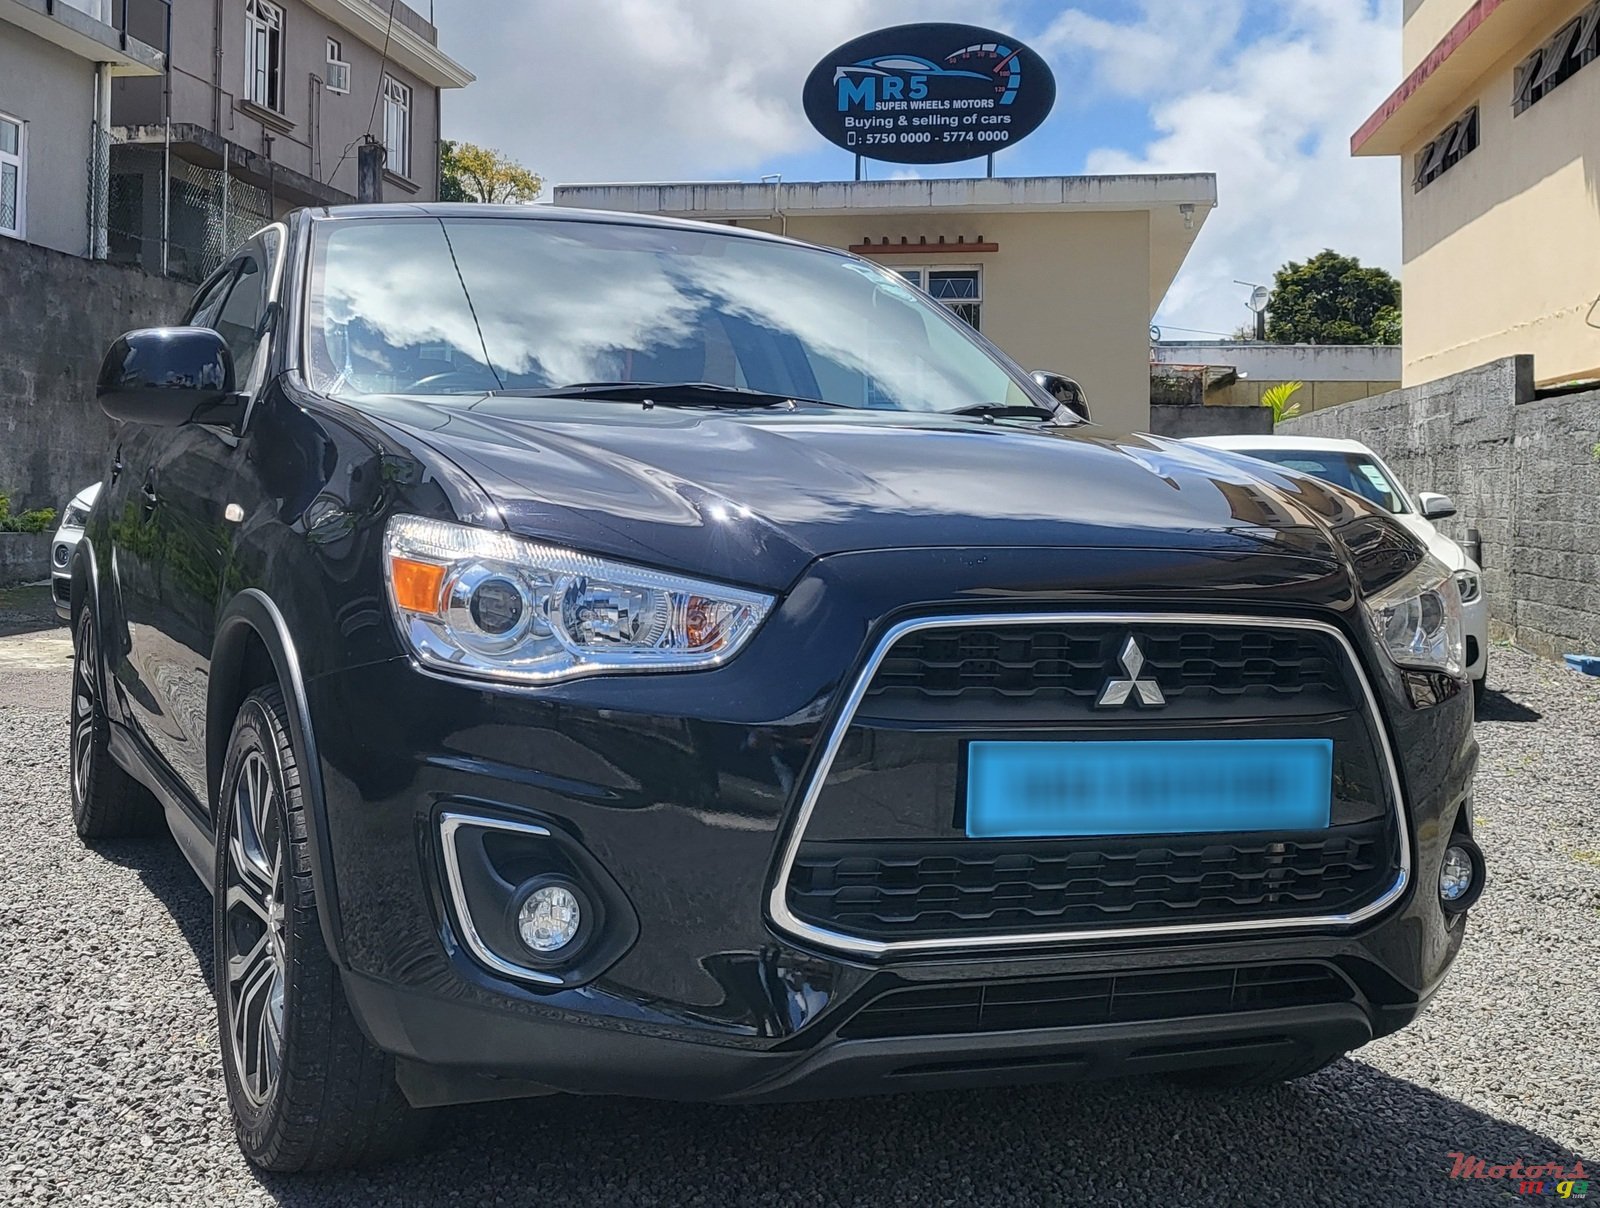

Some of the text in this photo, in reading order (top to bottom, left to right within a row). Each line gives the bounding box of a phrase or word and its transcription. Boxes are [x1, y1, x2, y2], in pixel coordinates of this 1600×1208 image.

[875, 99, 994, 111] SUPER WHEELS MOTORS
[845, 113, 1011, 129] Buying & selling of cars
[866, 133, 897, 144] 5750
[900, 132, 931, 143] 0000
[943, 131, 974, 142] 5774
[977, 130, 1009, 141] 0000
